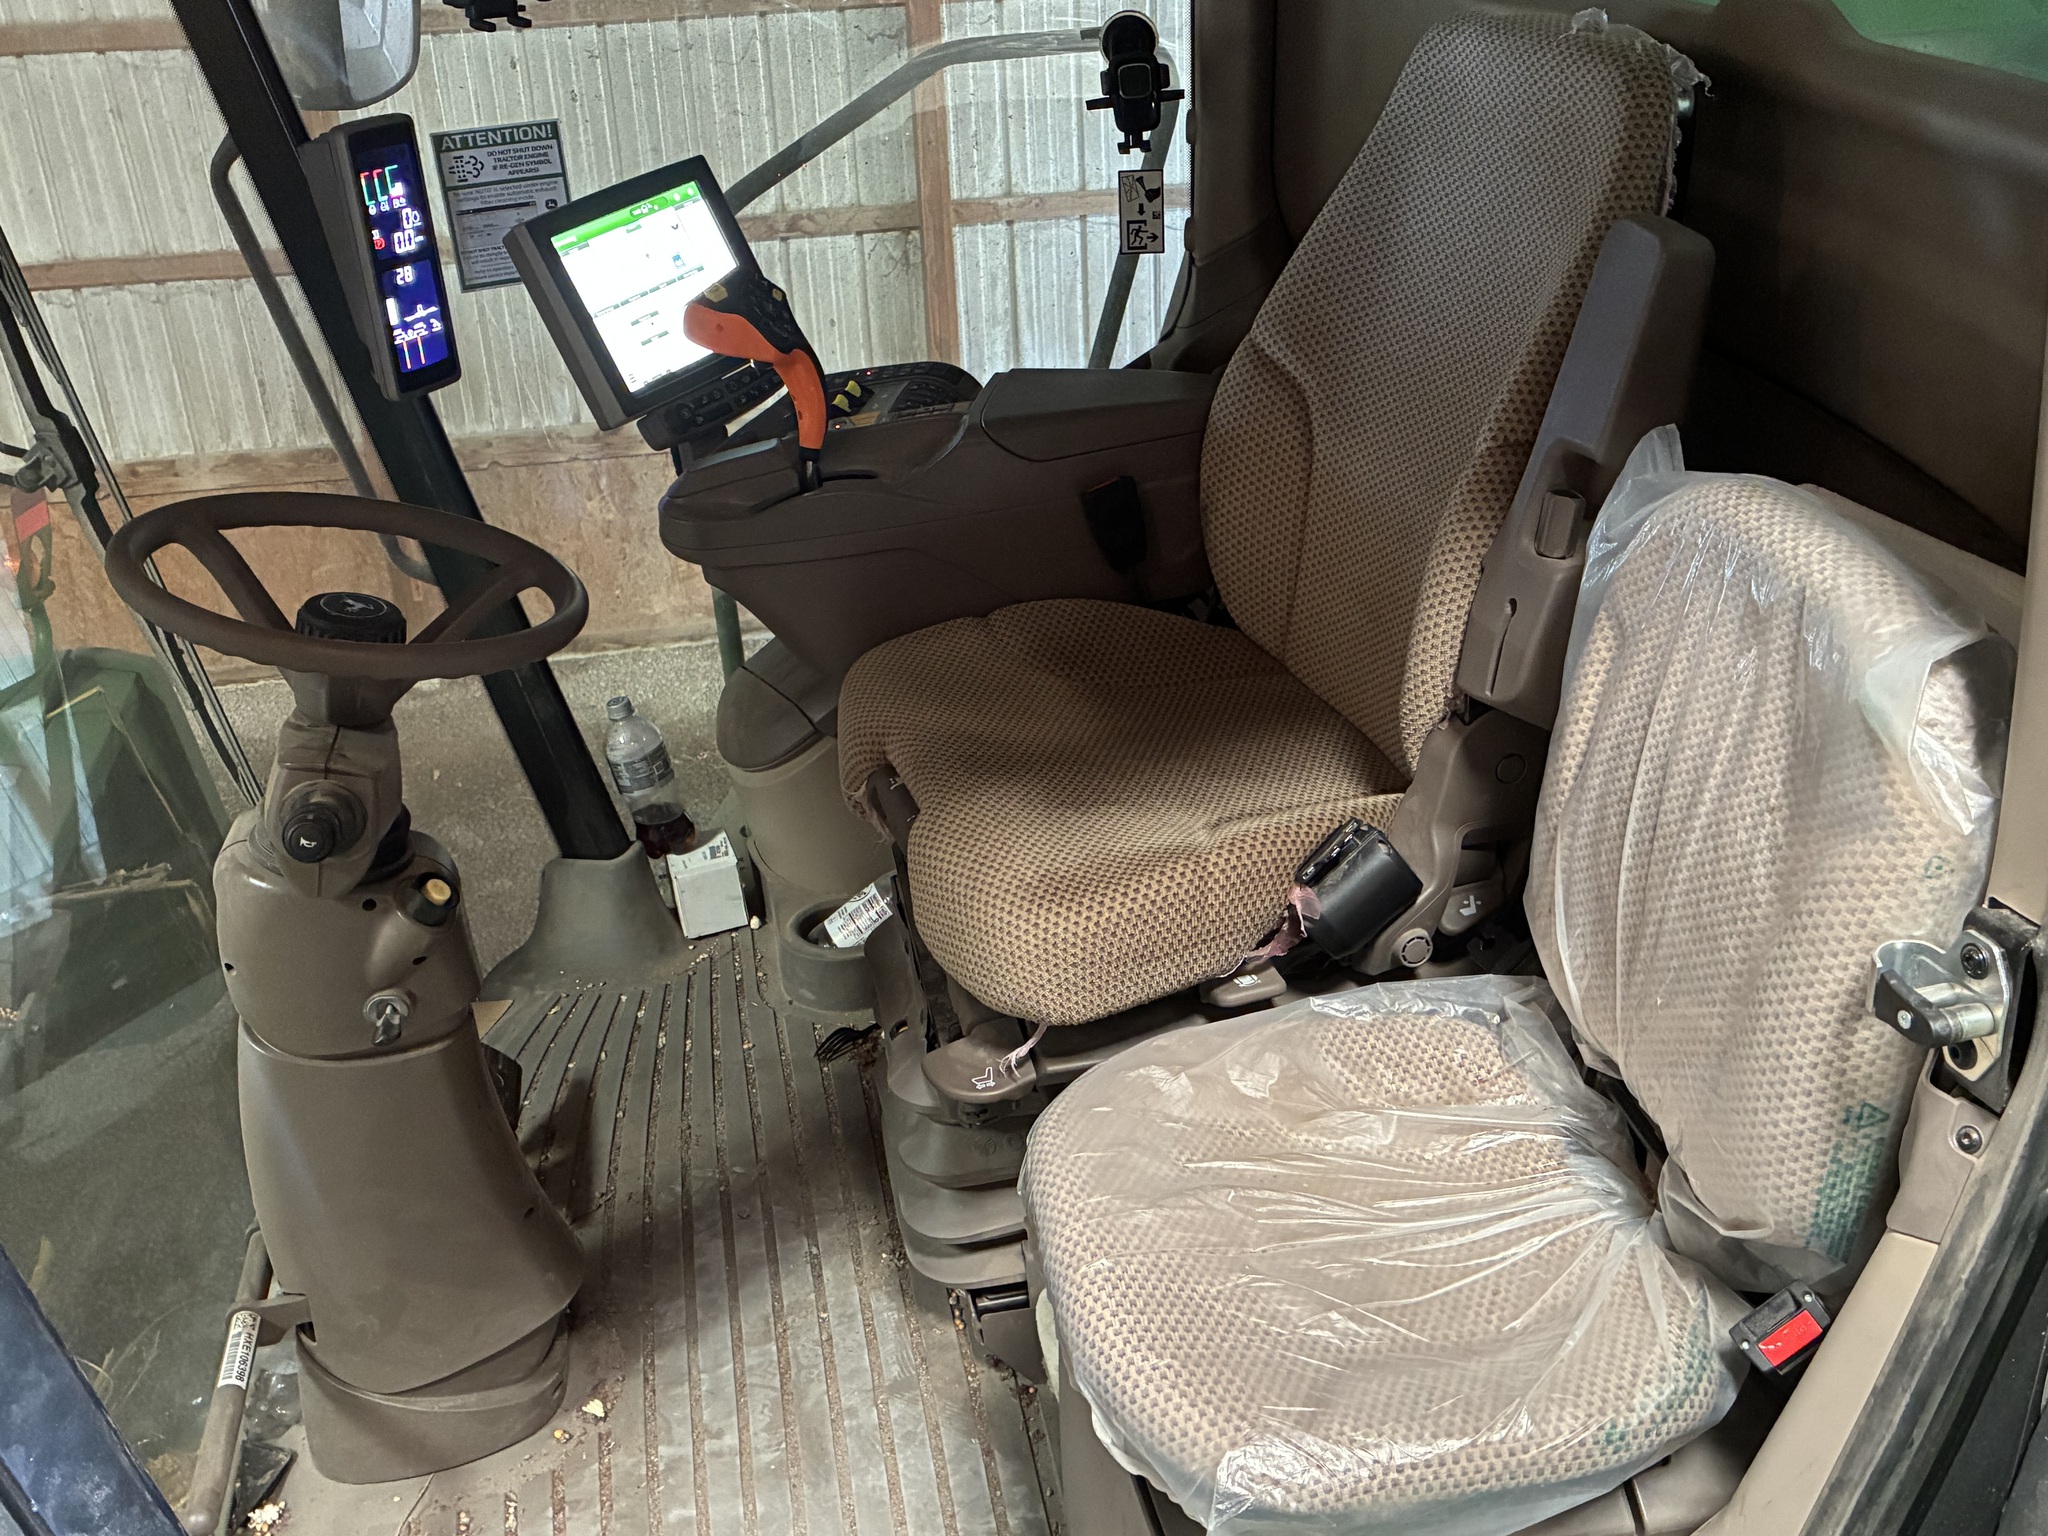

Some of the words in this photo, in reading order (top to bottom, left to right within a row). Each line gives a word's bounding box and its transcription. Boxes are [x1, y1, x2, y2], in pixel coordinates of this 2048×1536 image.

[441, 123, 553, 150] ATTENTION!
[497, 148, 512, 156] NOT
[512, 146, 530, 154] SHUT
[531, 144, 553, 152] DOWN
[493, 154, 523, 163] TRACTOR
[524, 152, 549, 160] ENGINE
[525, 159, 553, 168] SYMBOL
[235, 1332, 254, 1382] HXE106398
